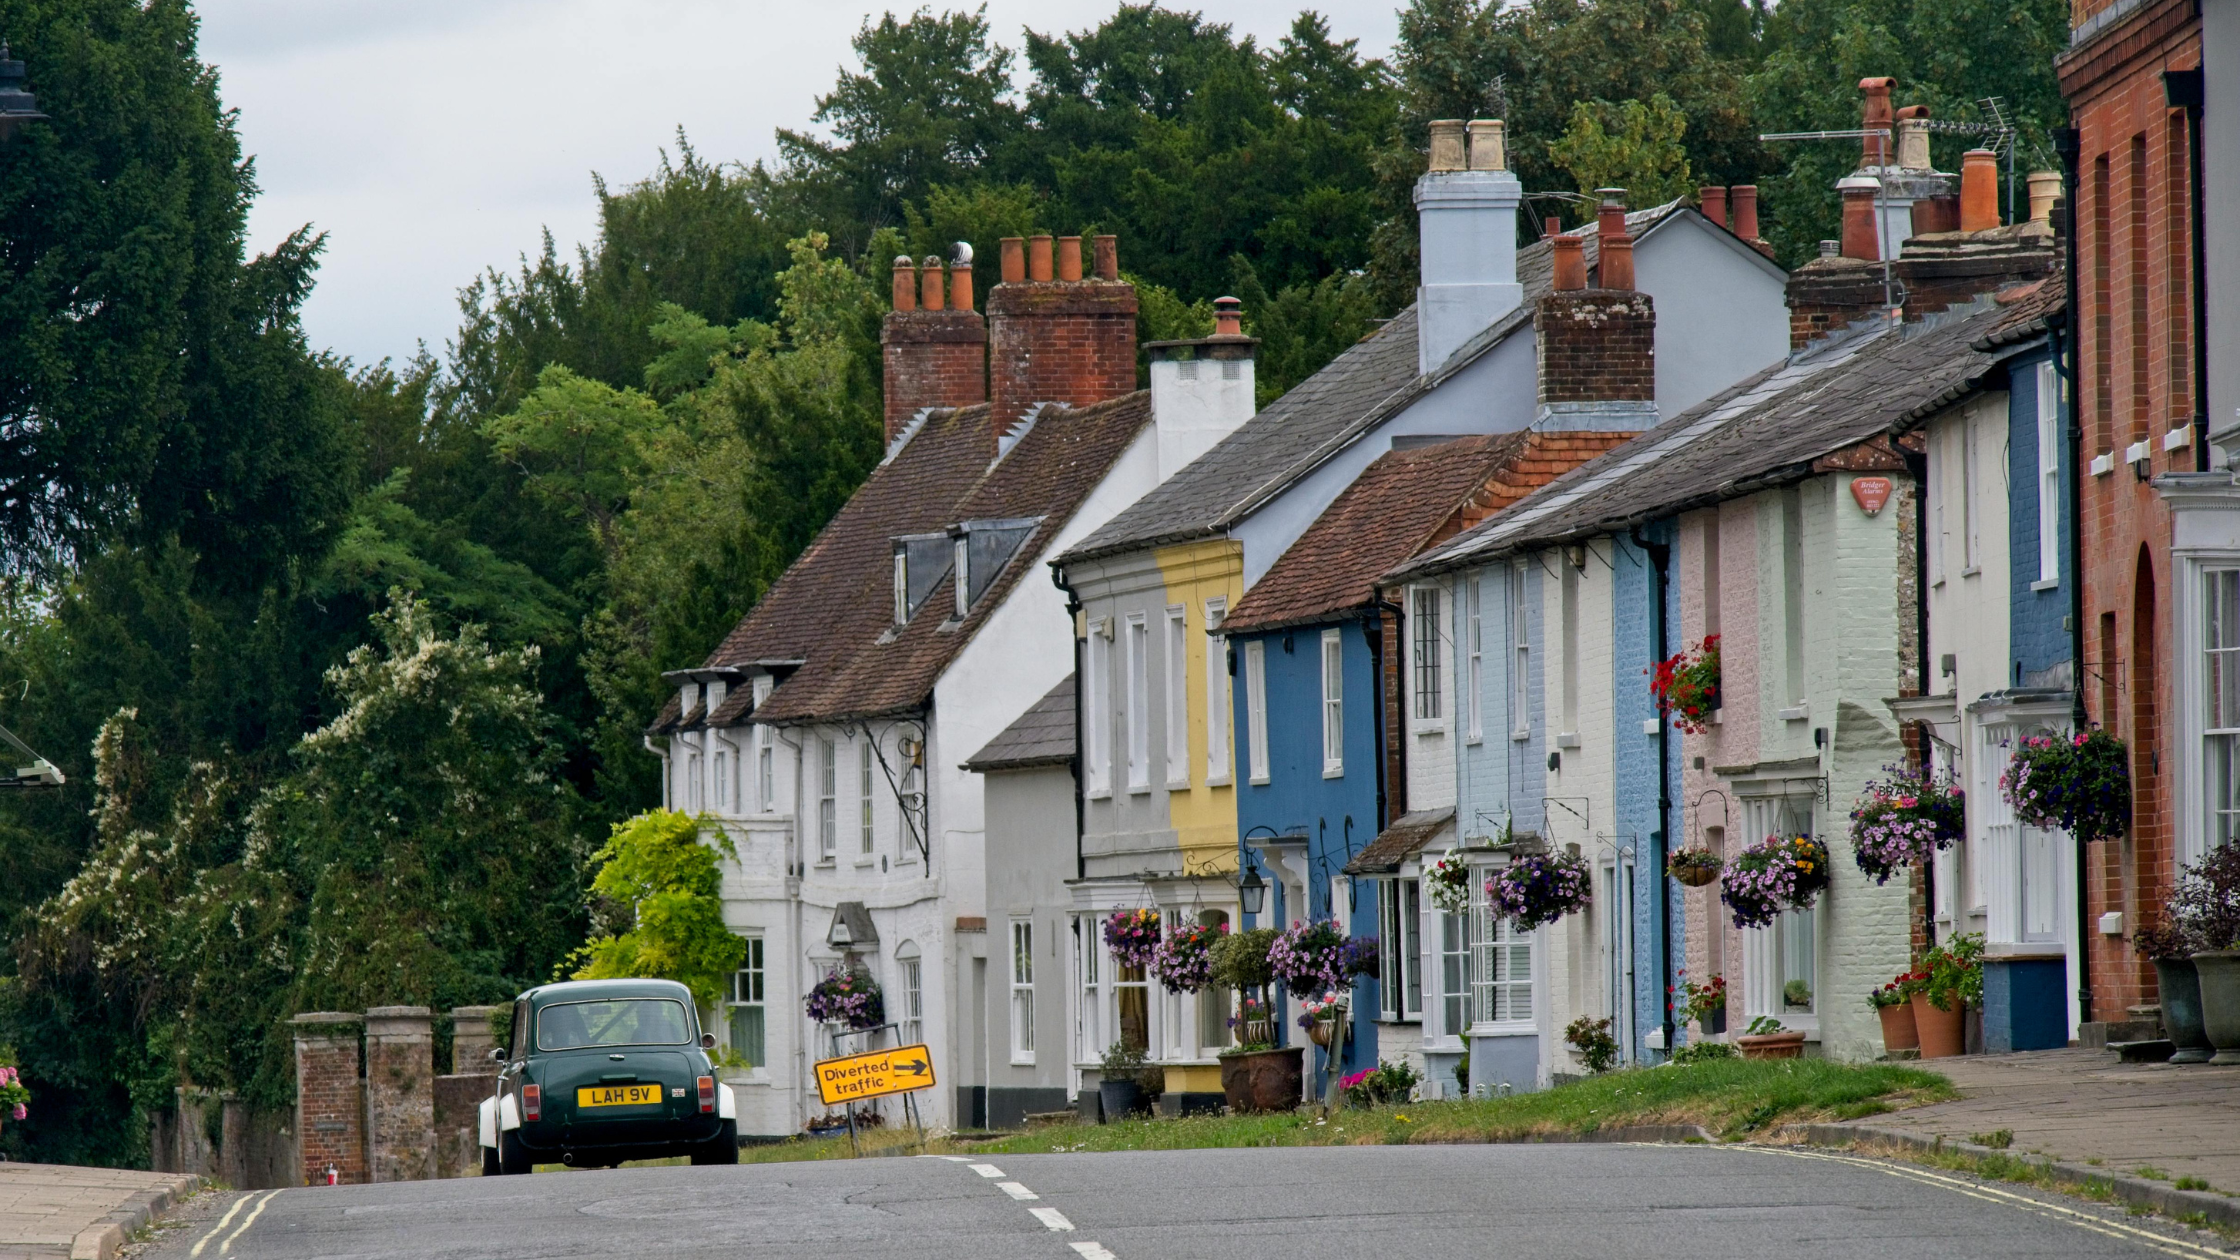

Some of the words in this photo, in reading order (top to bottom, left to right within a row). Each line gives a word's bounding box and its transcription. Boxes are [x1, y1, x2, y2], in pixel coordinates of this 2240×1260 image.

[1861, 481, 1885, 489] Bridger
[824, 1060, 889, 1082] Diverted
[835, 1077, 884, 1095] traffic
[592, 1089, 624, 1103] LAH
[629, 1088, 650, 1102] 9V
